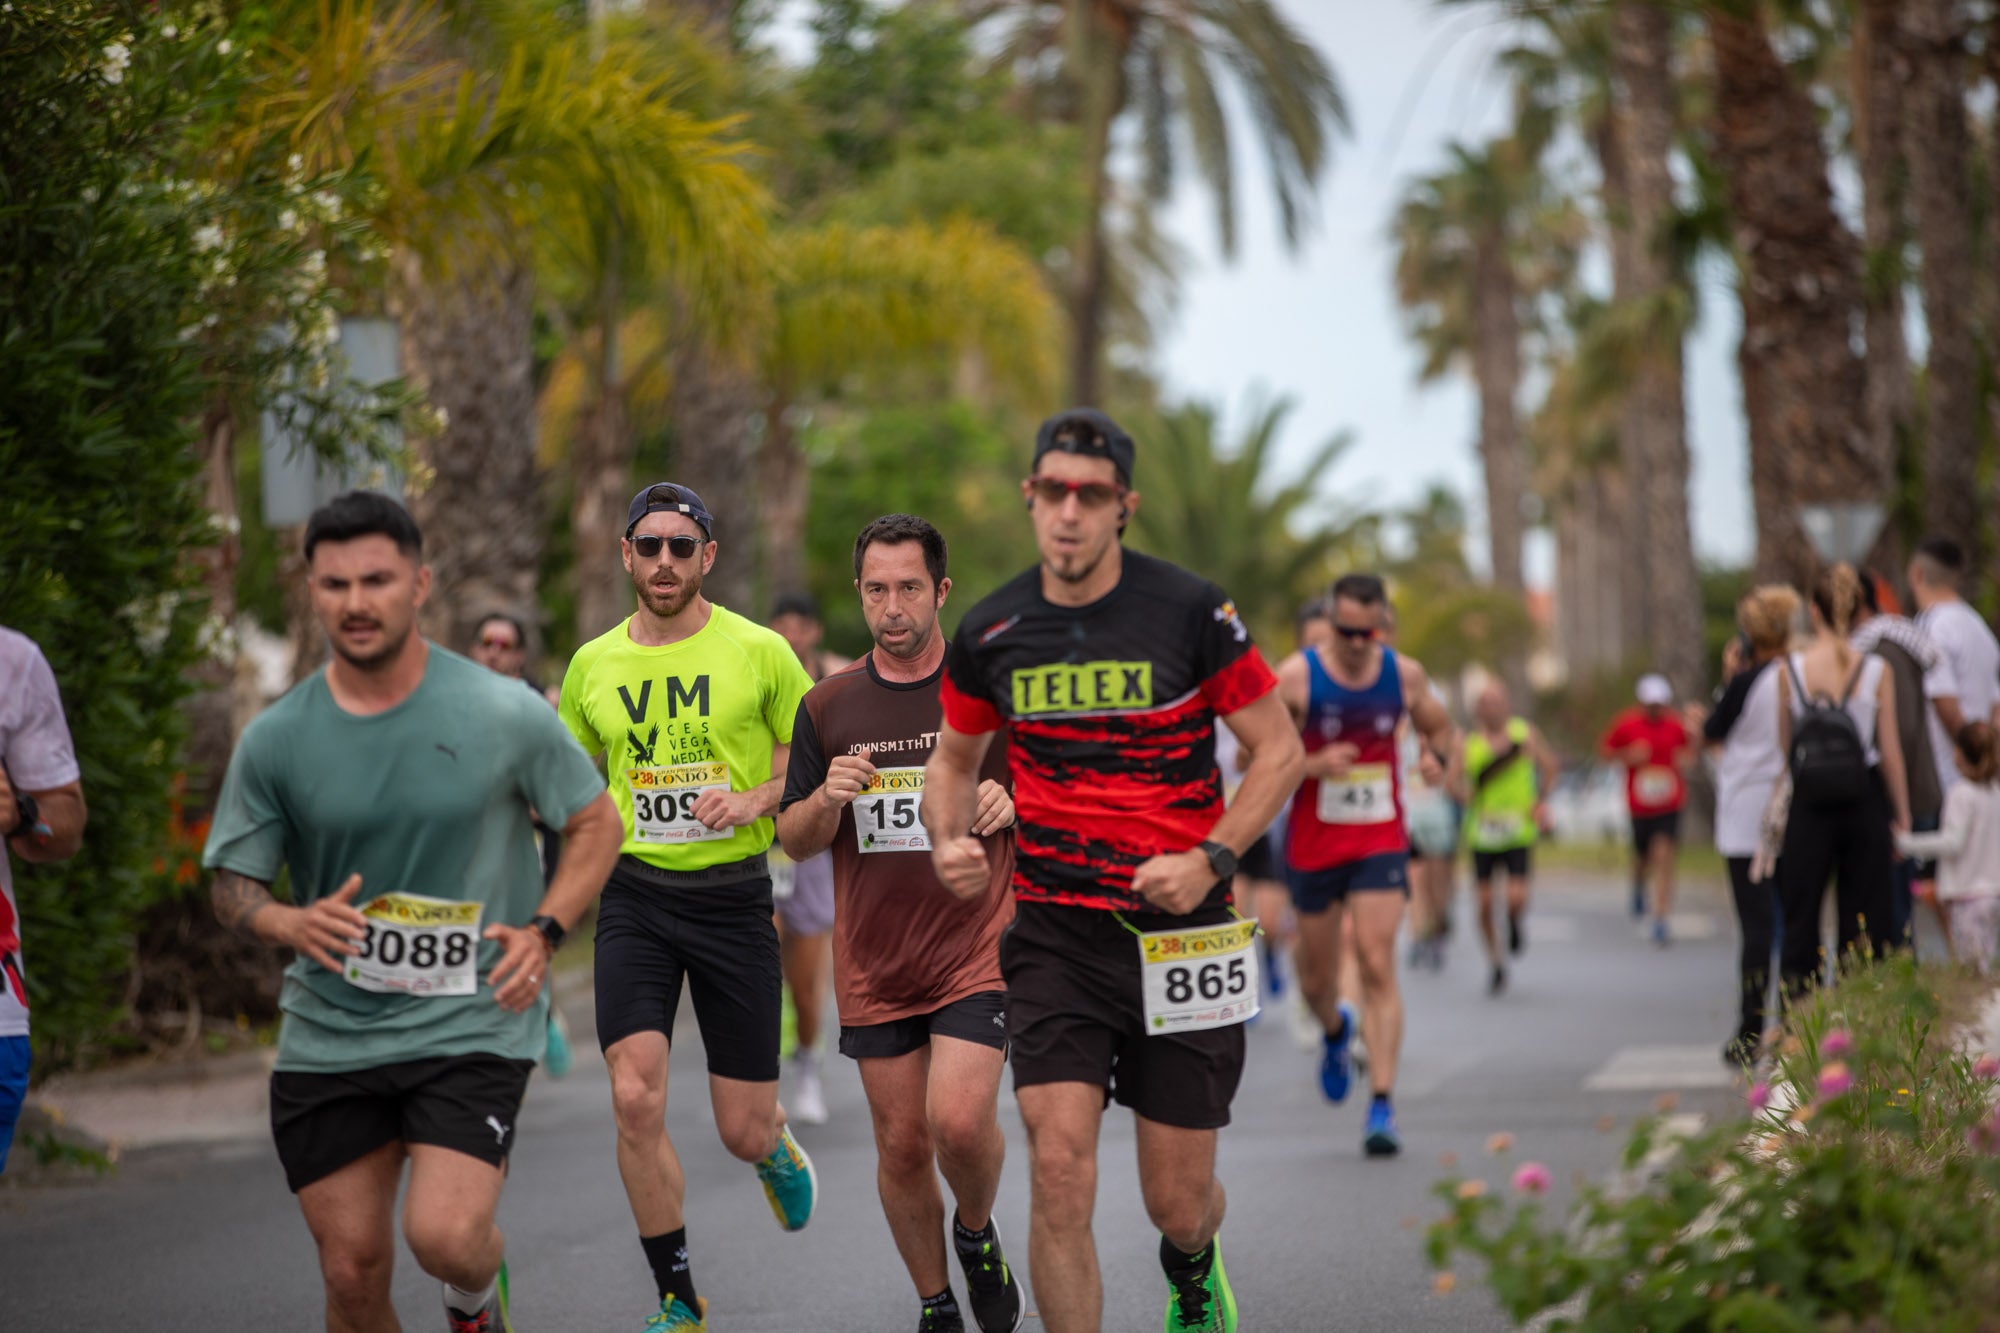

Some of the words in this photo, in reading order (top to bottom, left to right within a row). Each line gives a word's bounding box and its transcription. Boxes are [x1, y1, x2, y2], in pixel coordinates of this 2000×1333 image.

[1018, 668, 1145, 708] TELEX
[667, 721, 709, 736] CES
[669, 736, 712, 751] VEGA
[671, 748, 715, 766] MEDIA
[640, 771, 653, 785] 38
[654, 772, 708, 786] FONDO
[881, 776, 925, 789] FOND
[636, 791, 700, 823] 309
[870, 798, 926, 830] 15
[1160, 936, 1181, 955] 38
[1165, 957, 1246, 1005] 865
